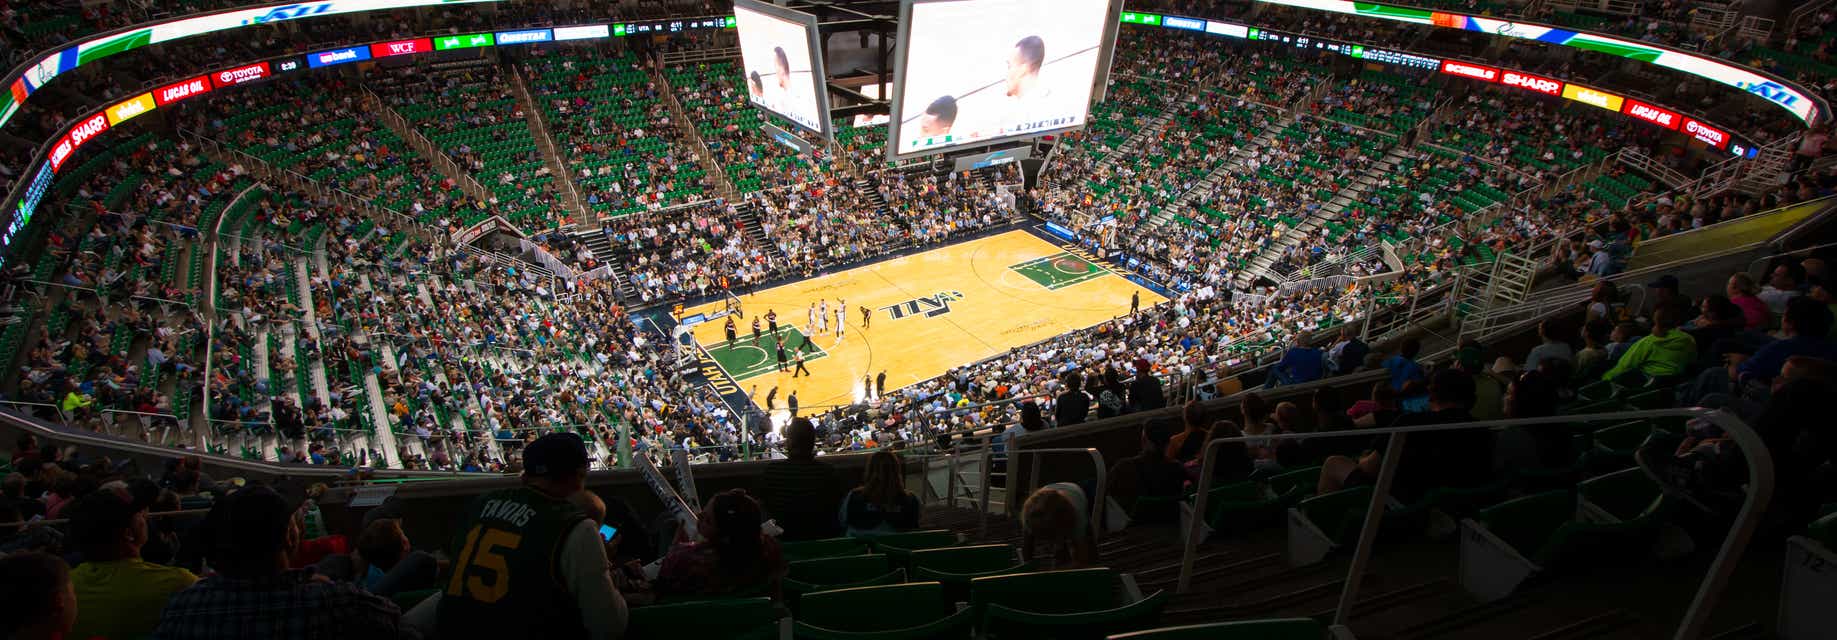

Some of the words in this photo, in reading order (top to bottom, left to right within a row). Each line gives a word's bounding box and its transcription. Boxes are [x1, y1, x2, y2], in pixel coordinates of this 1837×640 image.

[390, 42, 414, 53] WCF
[232, 66, 264, 79] TOYOTA
[163, 84, 190, 102] LUCAS
[190, 80, 204, 93] OIL
[1630, 104, 1659, 120] LUCAS
[1657, 112, 1672, 126] OIL
[1697, 125, 1722, 143] TOYOTA
[702, 366, 738, 395] UTAH
[480, 498, 536, 528] FAVORS
[447, 523, 522, 604] 15
